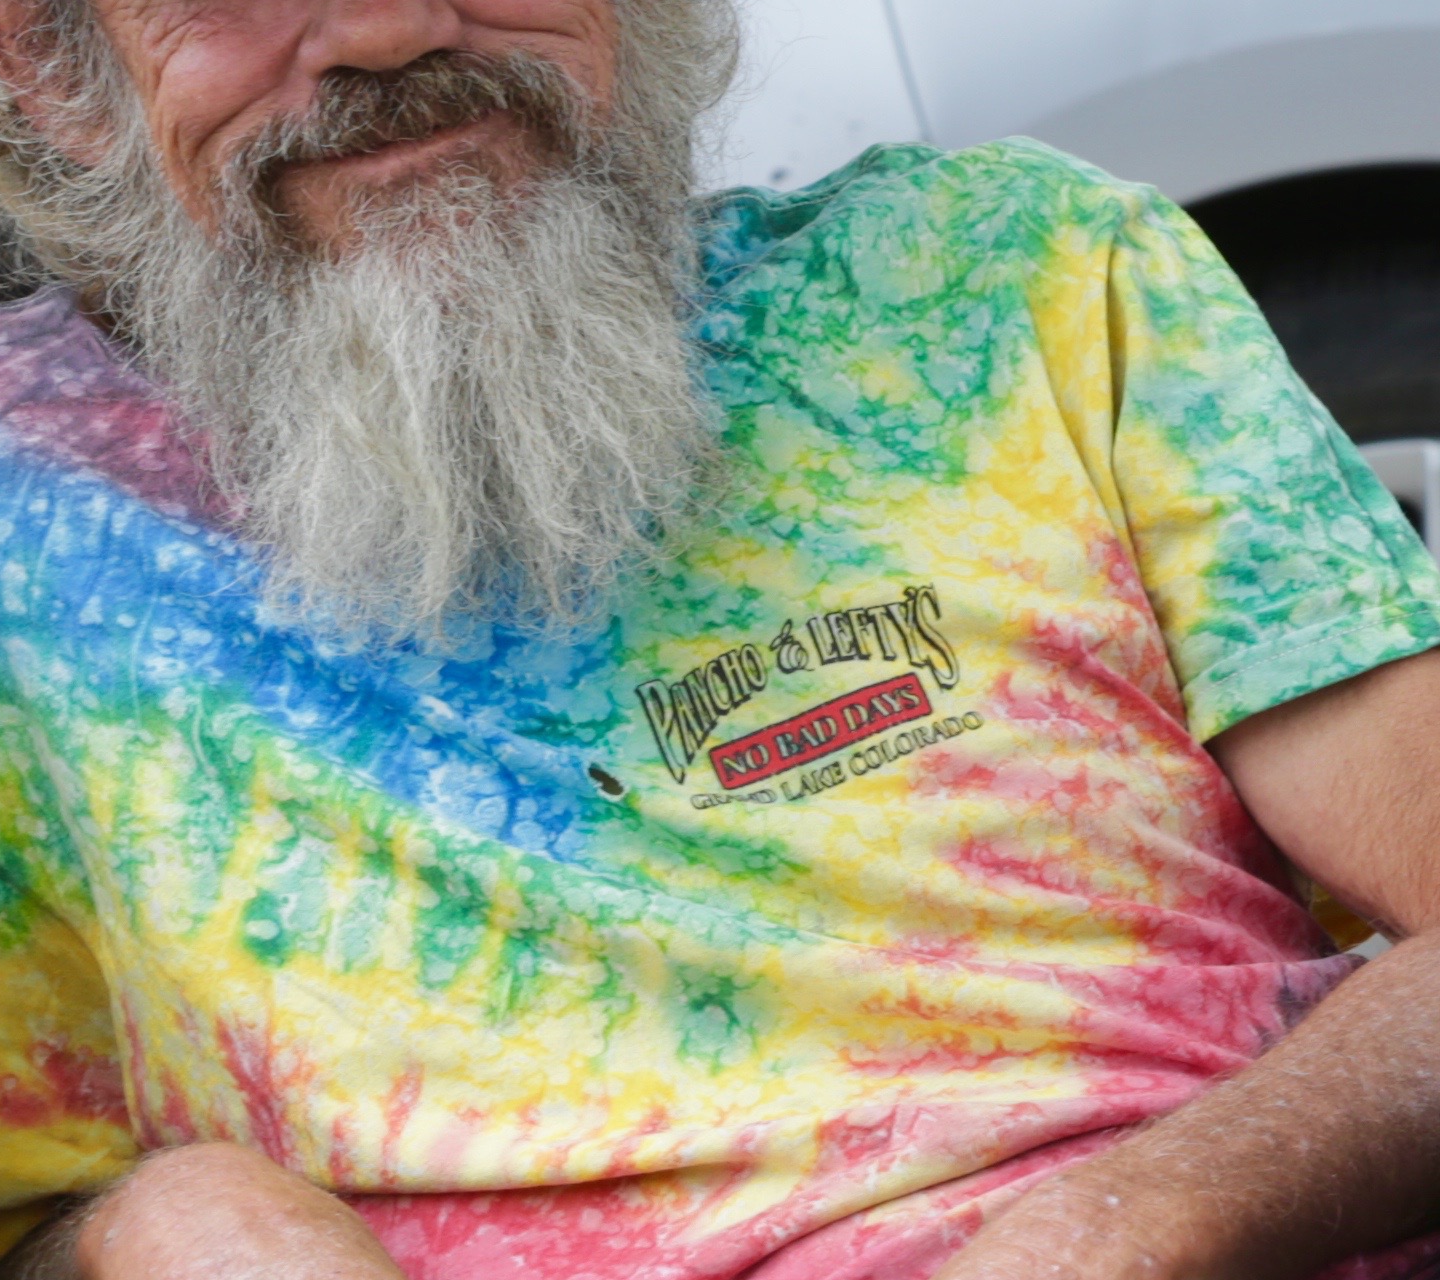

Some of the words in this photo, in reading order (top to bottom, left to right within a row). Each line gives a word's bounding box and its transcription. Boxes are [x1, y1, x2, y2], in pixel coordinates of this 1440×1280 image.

[634, 643, 768, 785] PANCHO
[806, 582, 960, 692] LEFTY'S
[720, 742, 771, 782] NO
[775, 716, 839, 760] BAD
[840, 683, 923, 734] DAYS
[780, 761, 847, 802] LAKE
[849, 711, 984, 776] COLORADO
